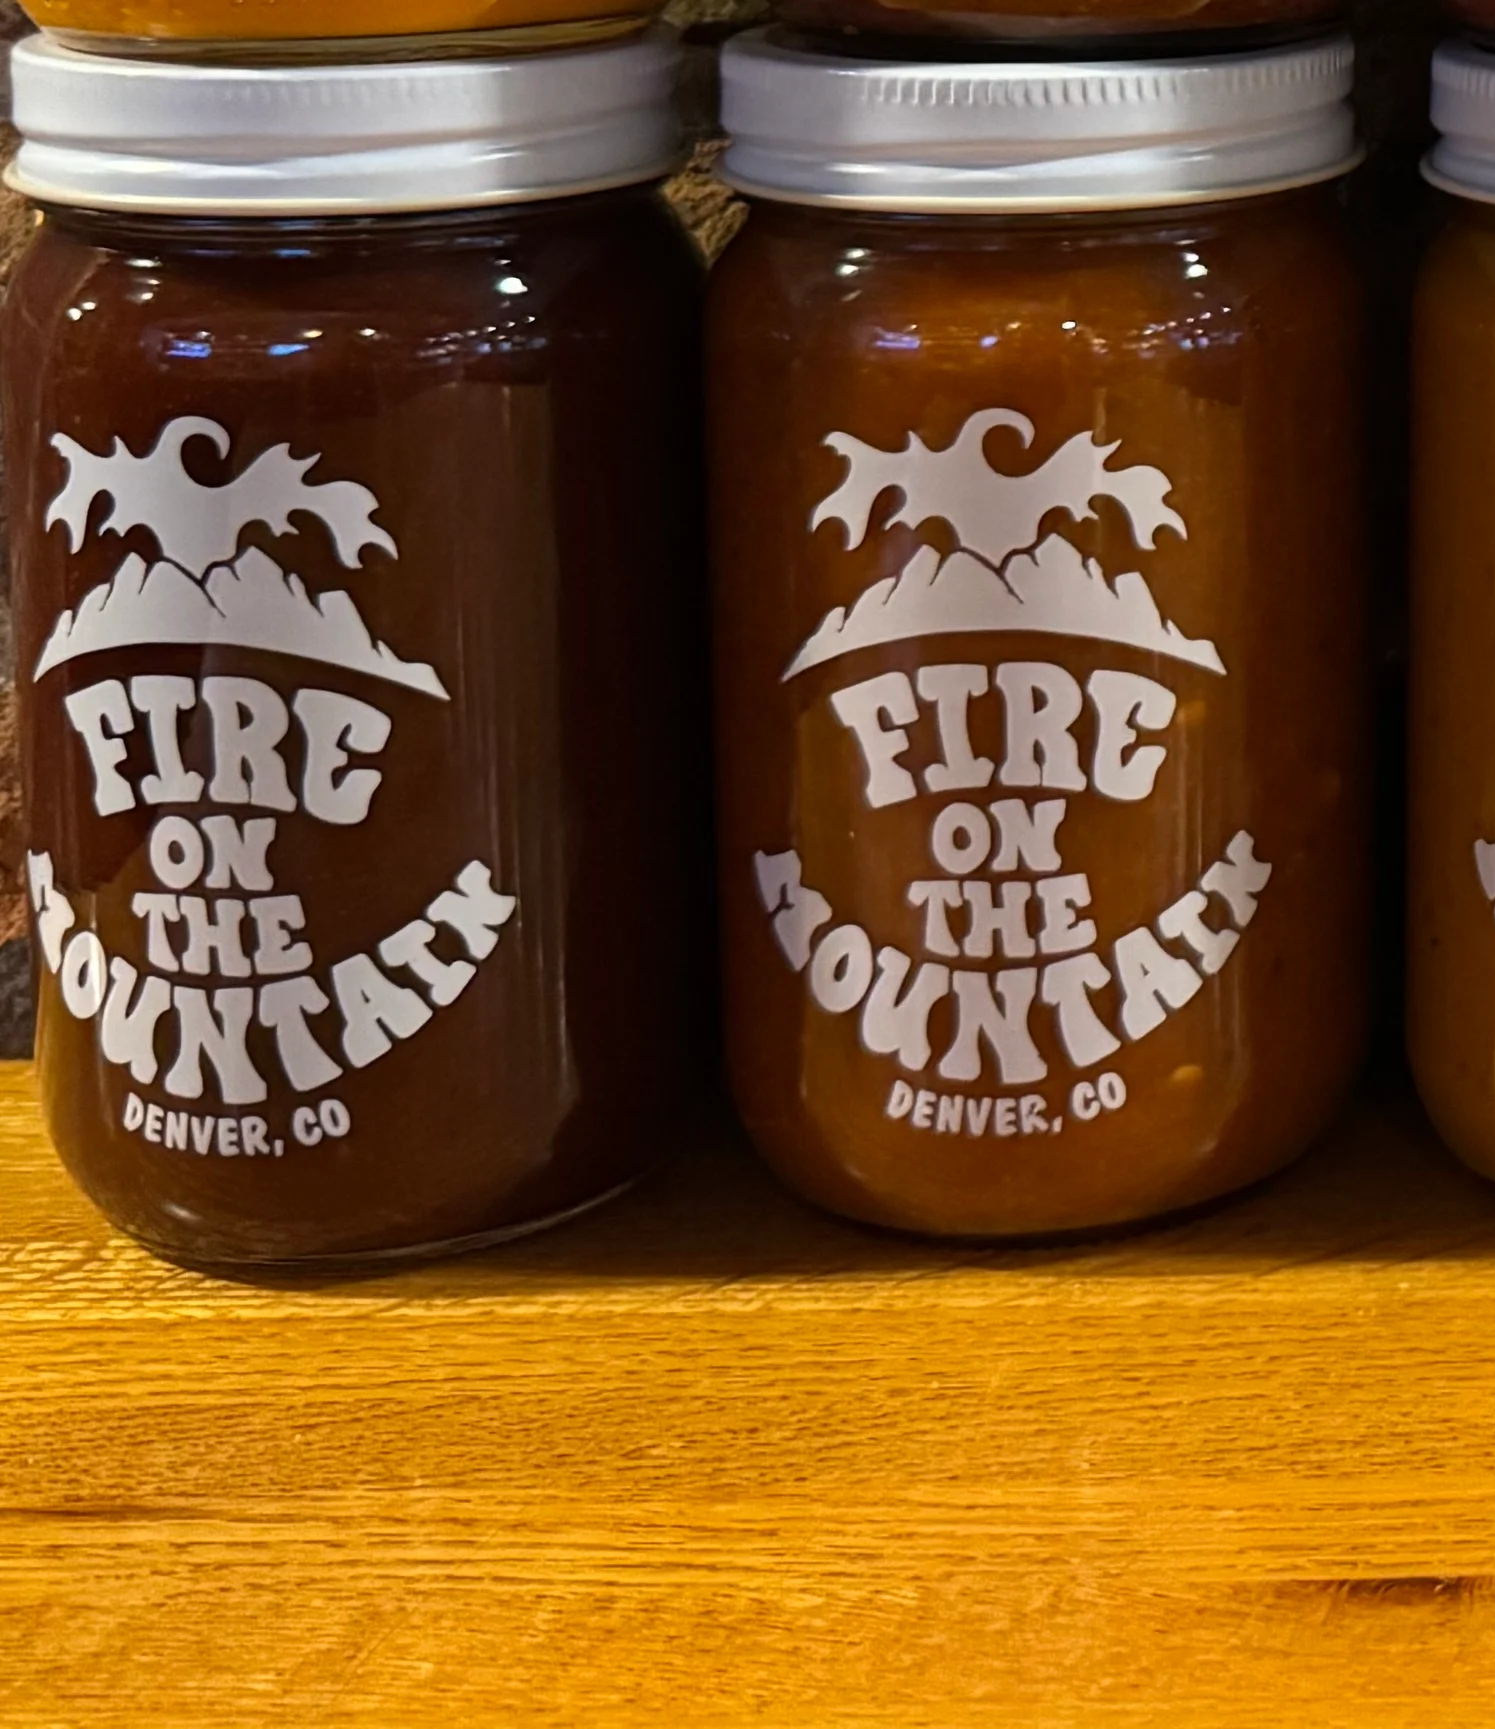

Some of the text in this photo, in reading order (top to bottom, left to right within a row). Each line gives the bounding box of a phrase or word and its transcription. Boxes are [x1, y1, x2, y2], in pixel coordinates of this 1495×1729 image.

[65, 674, 390, 825] FIRE
[831, 663, 1176, 810] FIRE
[150, 815, 276, 891] ON
[931, 799, 1065, 872] ON
[131, 894, 314, 976] THE
[755, 830, 1272, 1085] MOUNTAIN
[908, 873, 1095, 959] THE
[27, 851, 515, 1103] MOUNTAIN
[122, 1091, 350, 1158] DENVER, CO
[885, 1072, 1127, 1138] DENVER, CO
